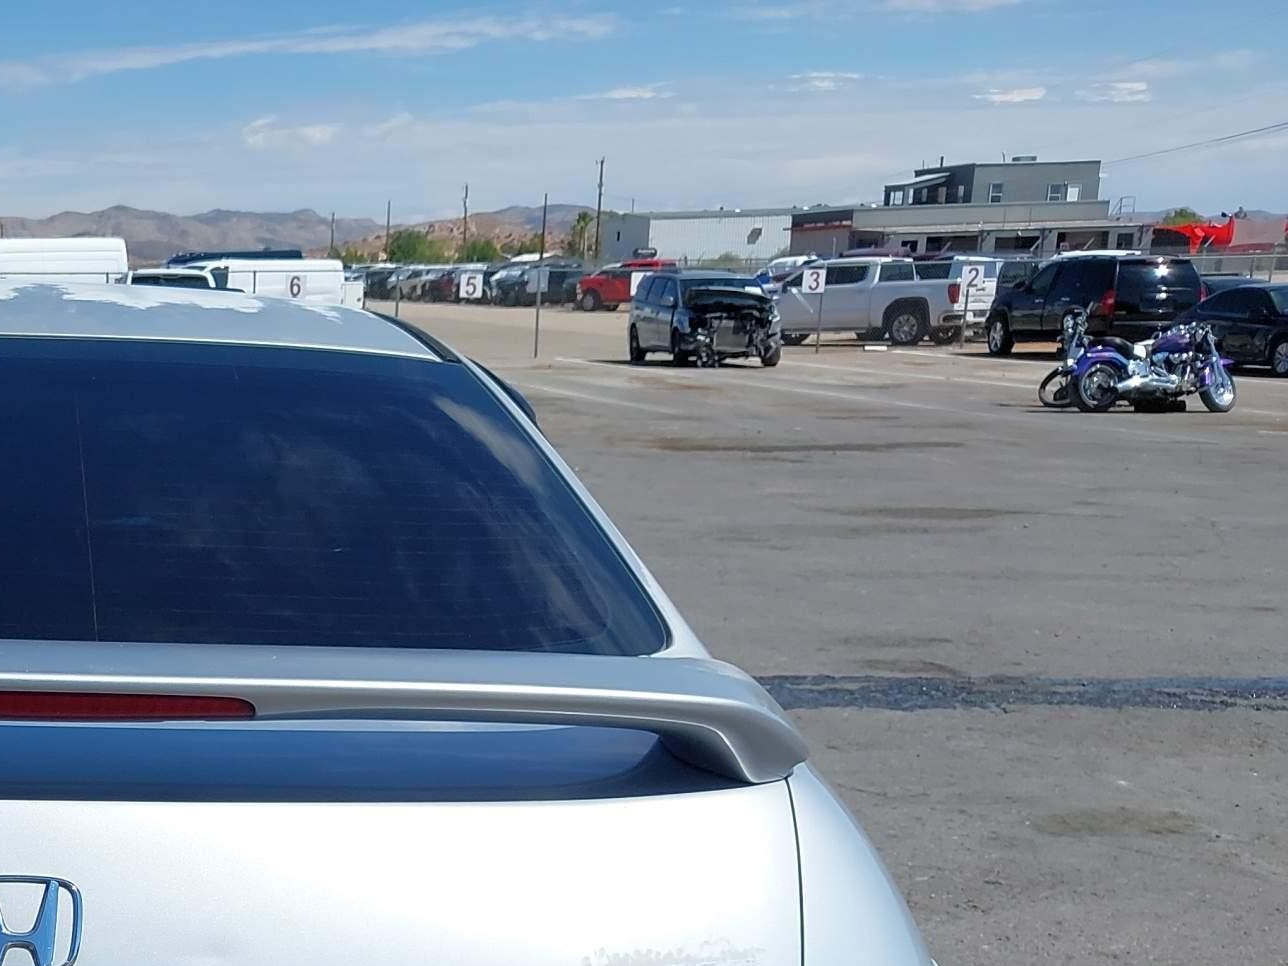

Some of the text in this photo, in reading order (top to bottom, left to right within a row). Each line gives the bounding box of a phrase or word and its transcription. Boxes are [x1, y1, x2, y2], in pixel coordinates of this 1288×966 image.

[289, 275, 301, 298] 6
[465, 276, 477, 297] 5
[808, 271, 820, 291] 3
[966, 267, 980, 288] 2
